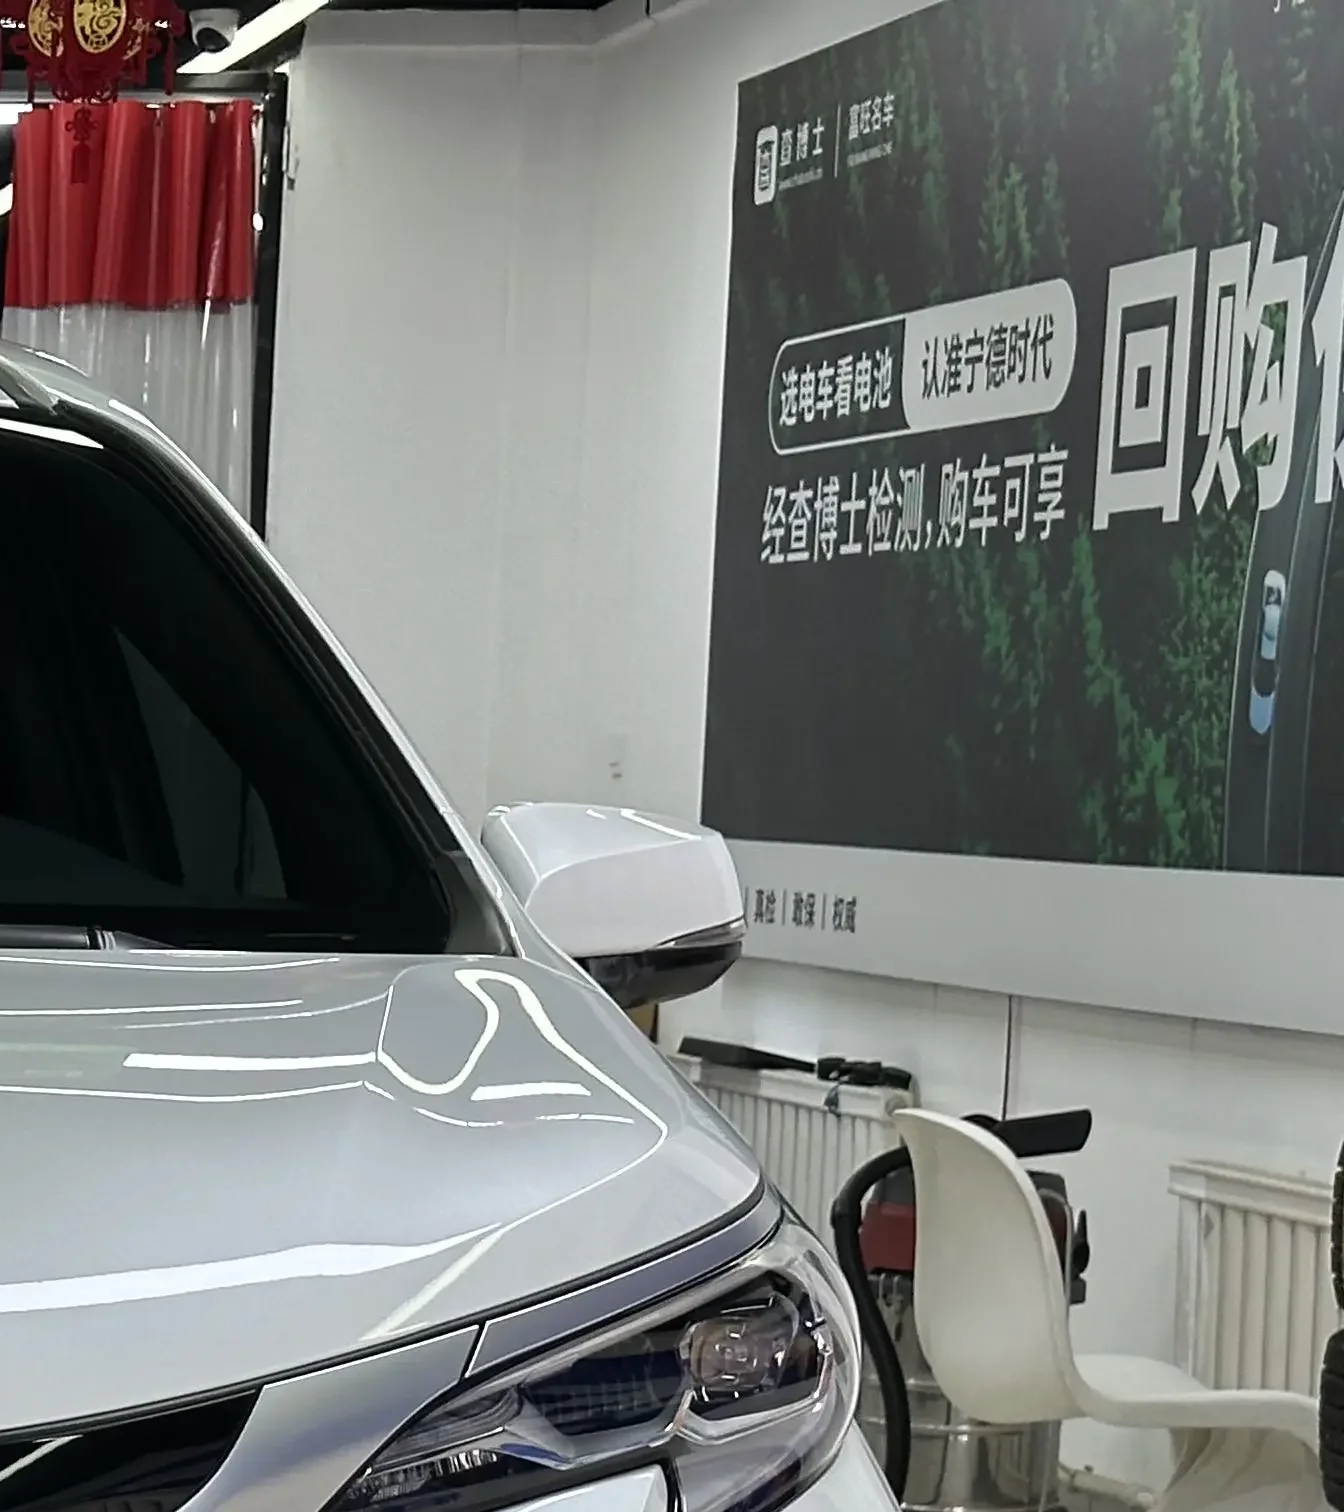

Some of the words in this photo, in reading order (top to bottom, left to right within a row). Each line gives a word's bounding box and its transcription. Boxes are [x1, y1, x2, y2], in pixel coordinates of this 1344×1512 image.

[779, 345, 893, 427] 选电车看电池
[922, 313, 1054, 400] 认准宁德时代
